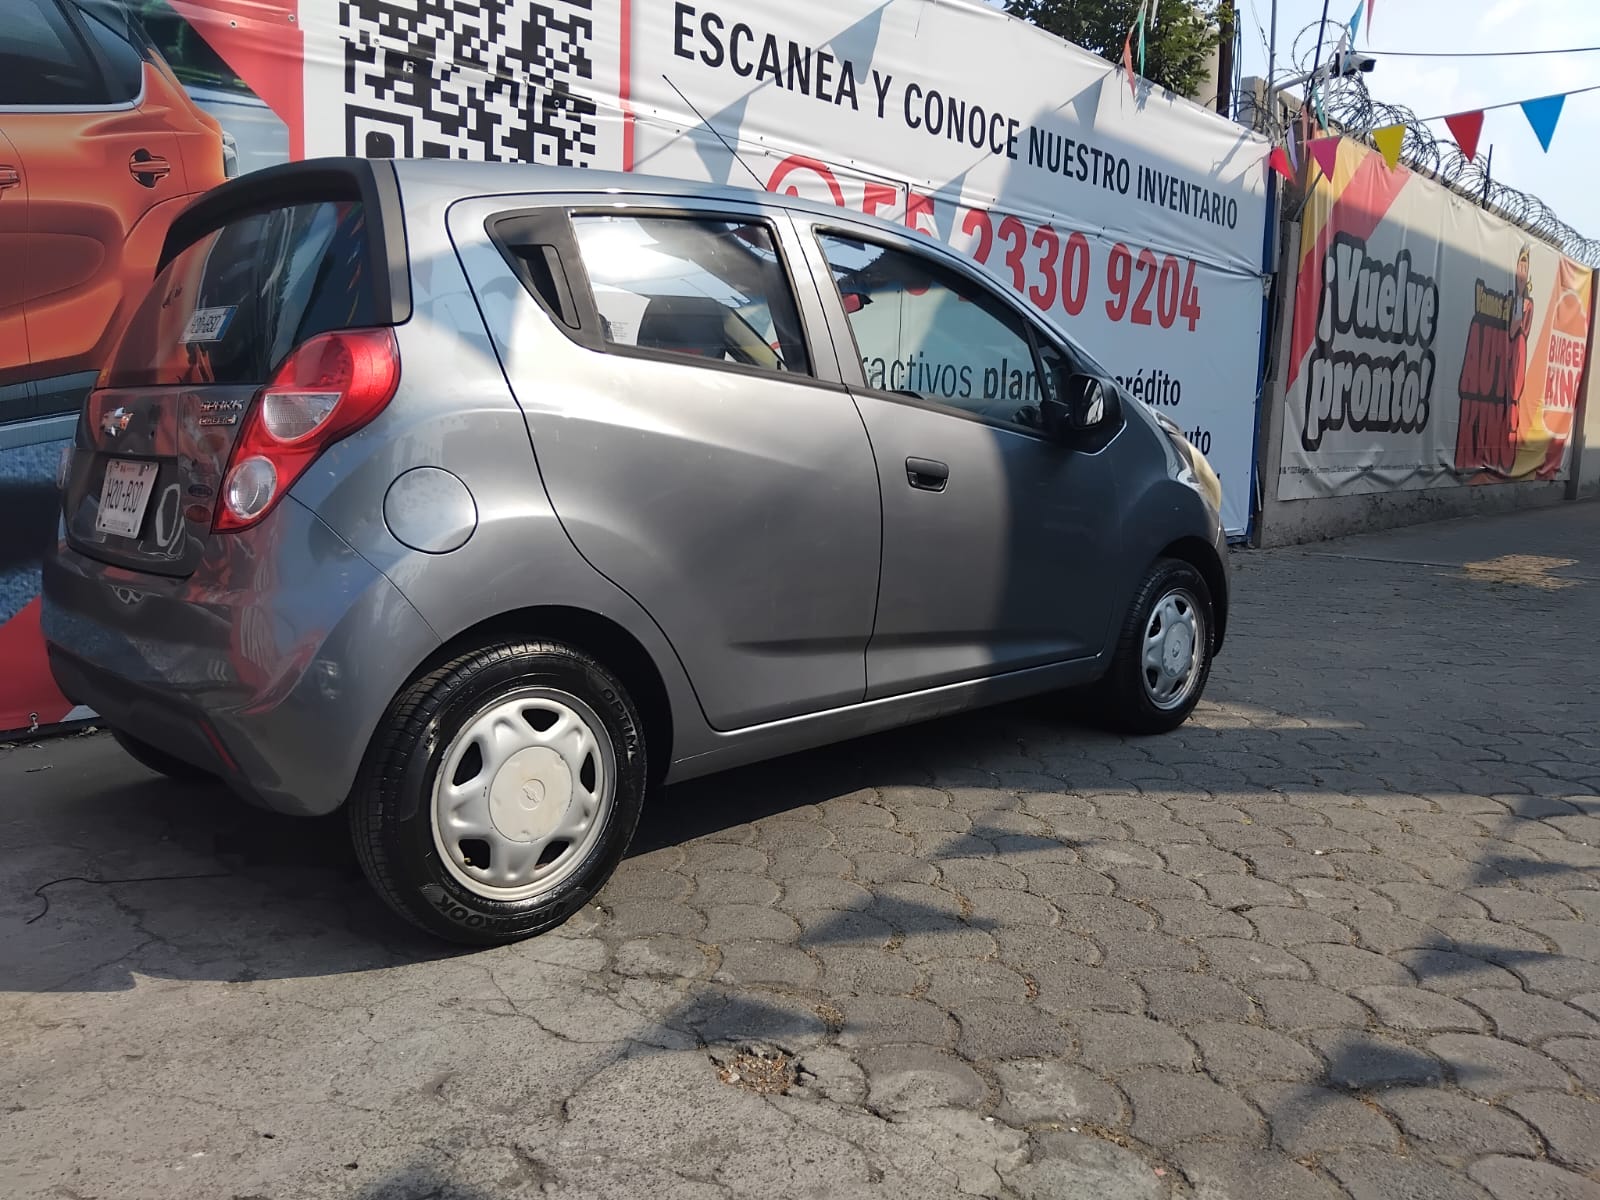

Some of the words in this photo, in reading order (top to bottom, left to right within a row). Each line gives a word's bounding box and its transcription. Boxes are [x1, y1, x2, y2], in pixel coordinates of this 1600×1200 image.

[674, 1, 858, 111] ESCANEA
[872, 69, 892, 119] Y
[903, 82, 1020, 160] CONOCE
[1029, 126, 1130, 195] NUESTRO
[1137, 165, 1238, 229] INVENTARIO
[1105, 242, 1200, 331] 9204
[1317, 236, 1437, 346] ¡Vuelve
[1304, 352, 1434, 447] pronto!
